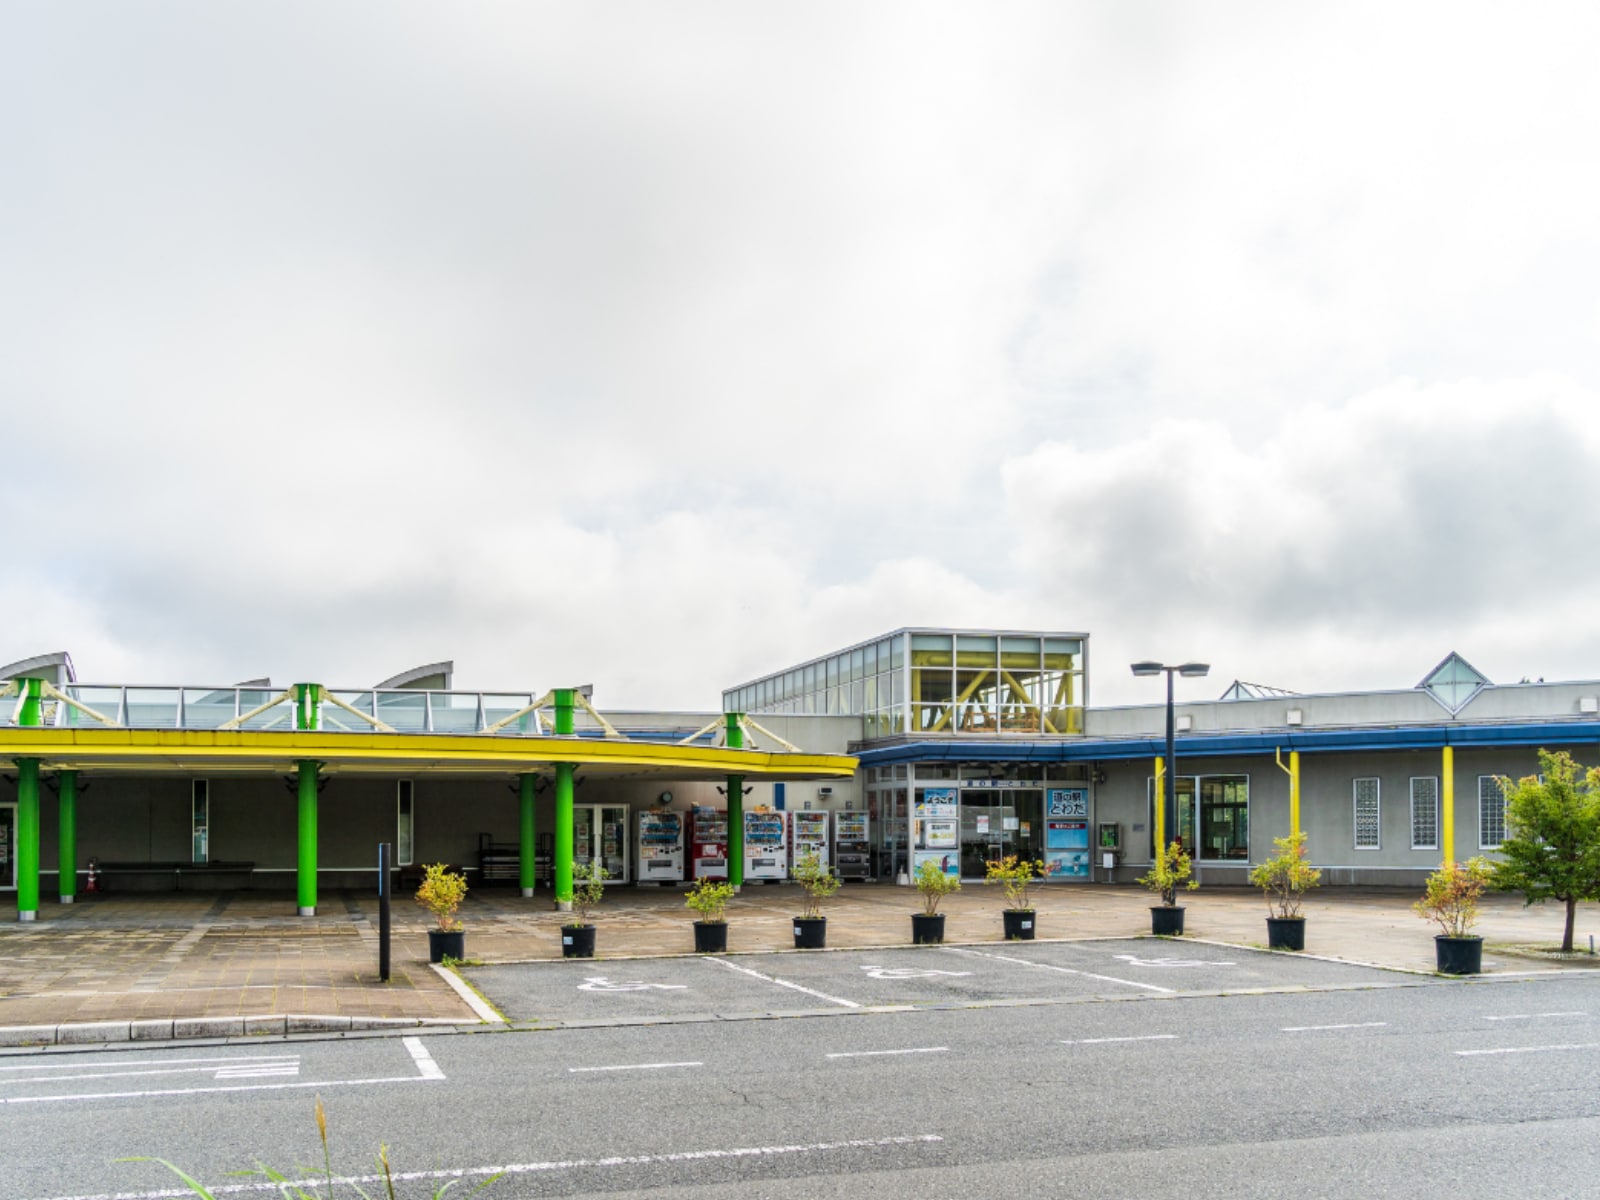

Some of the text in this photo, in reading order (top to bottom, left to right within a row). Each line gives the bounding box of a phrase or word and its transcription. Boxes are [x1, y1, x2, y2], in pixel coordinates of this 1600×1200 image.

[1053, 792, 1081, 802] 道の駅
[1050, 803, 1085, 815] とわだ
